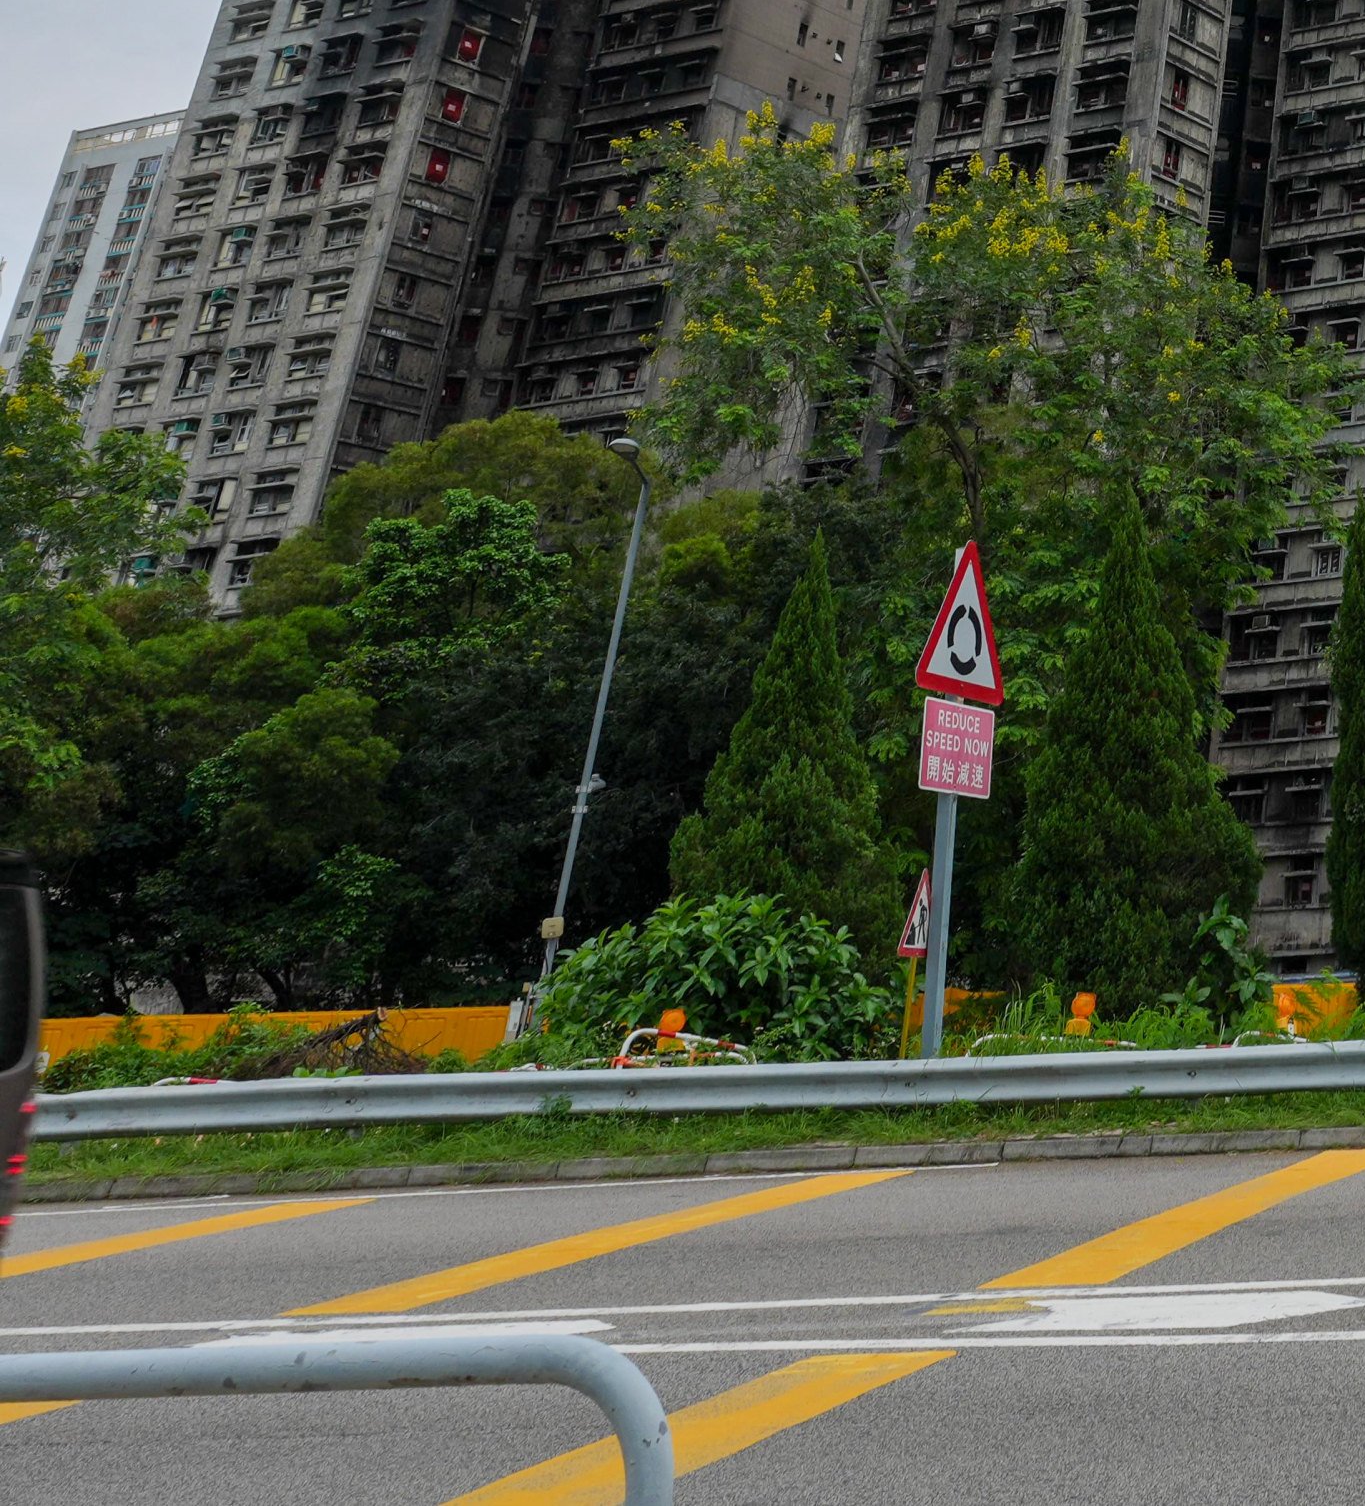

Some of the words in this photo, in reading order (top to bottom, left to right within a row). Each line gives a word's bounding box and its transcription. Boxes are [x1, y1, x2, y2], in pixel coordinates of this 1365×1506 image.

[938, 709, 980, 733] REDUCE
[926, 730, 961, 751] SPEED
[964, 737, 989, 757] NOW
[927, 755, 984, 788] 開始減速
